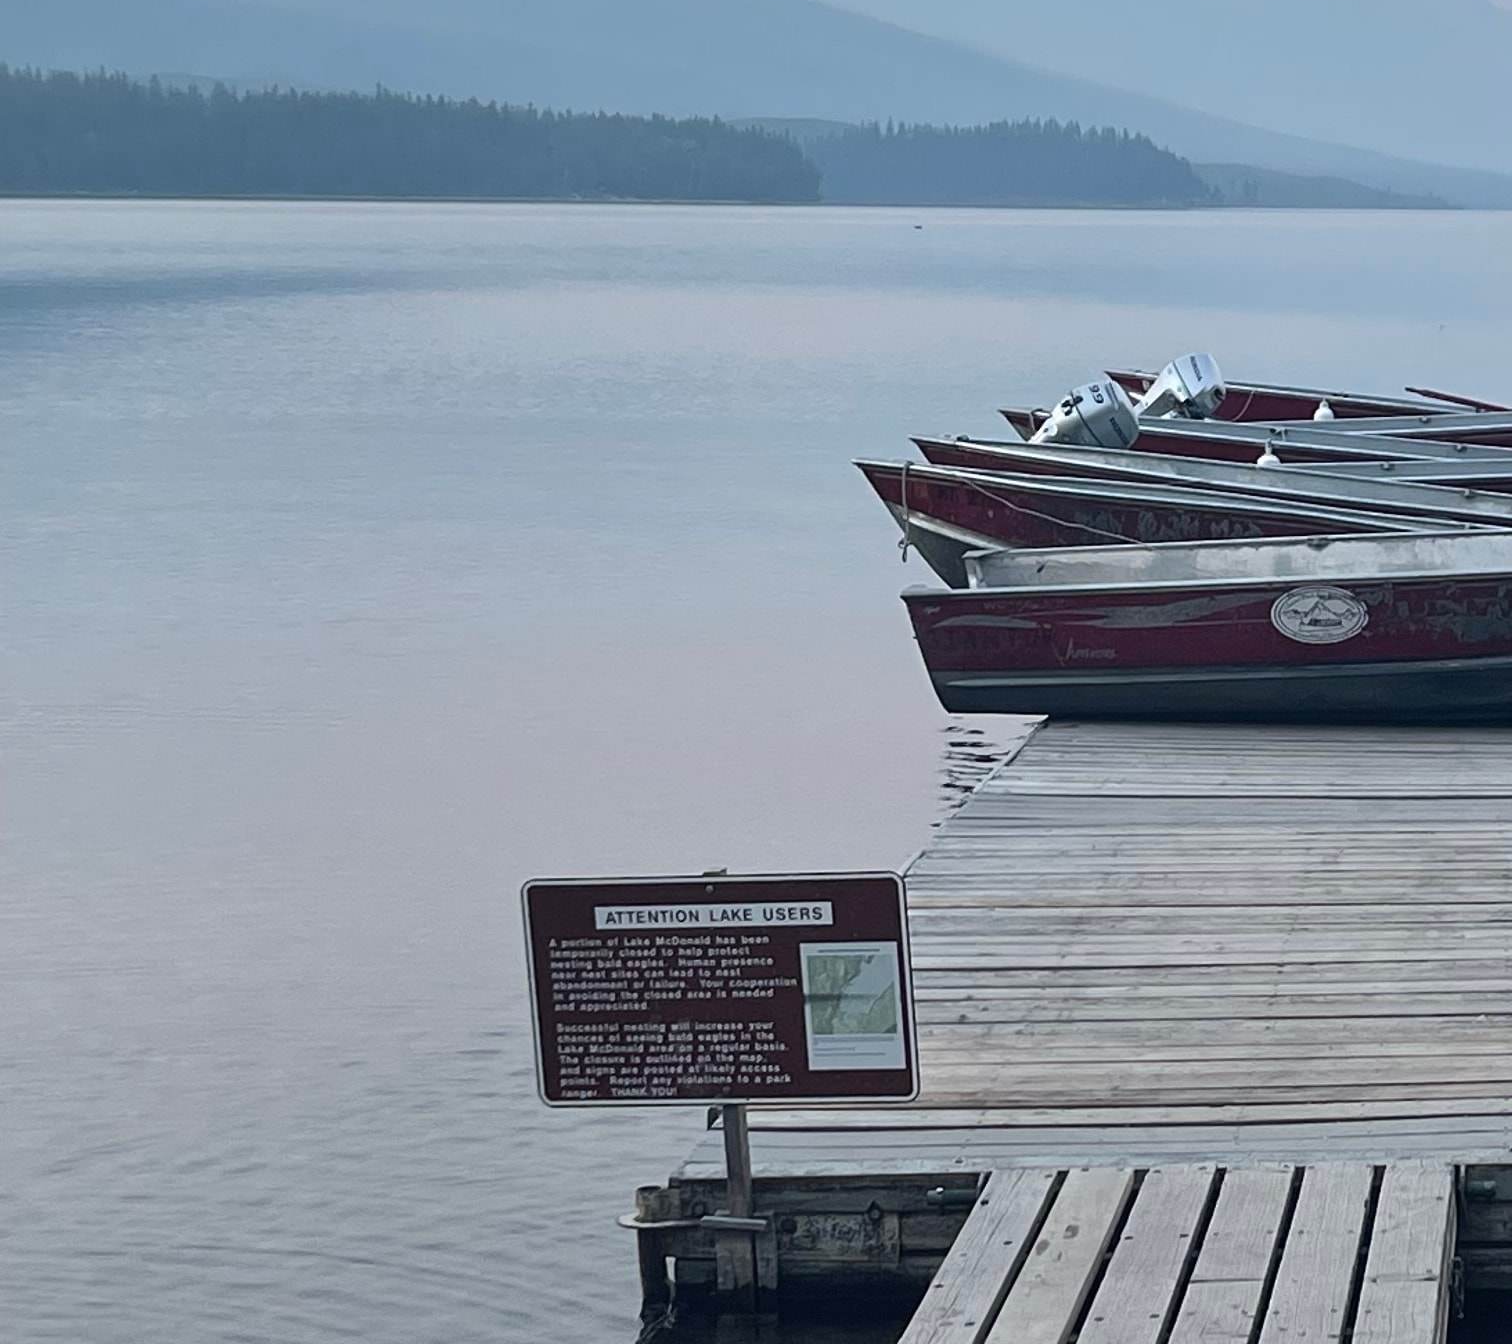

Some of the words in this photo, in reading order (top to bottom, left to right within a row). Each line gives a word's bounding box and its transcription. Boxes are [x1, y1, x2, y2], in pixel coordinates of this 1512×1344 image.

[606, 910, 699, 924] ATTENTION
[710, 908, 753, 922] LAKE
[763, 906, 823, 921] USERS
[549, 938, 557, 947] A
[561, 938, 601, 948] portion
[607, 938, 619, 946] of
[624, 937, 650, 946] Lake
[655, 936, 710, 945] McDonald
[715, 936, 736, 944] has
[741, 936, 770, 944] been
[619, 948, 656, 957] closed
[661, 948, 673, 956] to
[679, 947, 702, 956] help
[708, 946, 750, 956] protect
[550, 959, 592, 969] nesting
[597, 959, 622, 967] bald
[678, 957, 716, 967] Human
[721, 957, 774, 967] presence
[551, 971, 576, 979] near
[582, 970, 606, 978] nest
[611, 970, 639, 978] sites
[644, 970, 665, 978] can
[669, 969, 693, 977] lead
[699, 968, 711, 977] to
[716, 968, 741, 976] nest
[553, 980, 628, 990] abandonment
[699, 979, 724, 988] Your
[729, 977, 798, 988] cooperation
[553, 992, 564, 1000] in
[569, 991, 616, 1001] avoiding
[620, 991, 638, 999] the
[644, 990, 681, 999] closed
[687, 990, 711, 998] area
[716, 990, 727, 998] is
[732, 989, 774, 997] needed
[554, 1003, 575, 1011] and
[556, 1023, 619, 1033] Successful
[623, 1023, 666, 1032] nesting
[695, 1022, 743, 1030] increase
[749, 1022, 774, 1031] your
[557, 1034, 604, 1043] chances
[609, 1034, 620, 1043] of
[626, 1034, 664, 1043] seeing
[668, 1033, 693, 1041] bald
[698, 1033, 736, 1042] eagles
[741, 1032, 751, 1040] in
[756, 1032, 774, 1040] the
[557, 1045, 584, 1054] Lake
[589, 1044, 644, 1053] McDonald
[679, 1044, 693, 1052] on
[698, 1044, 705, 1052] a
[710, 1043, 750, 1052] regular
[559, 1055, 579, 1064] The
[584, 1055, 625, 1064] closure
[631, 1055, 641, 1063] is
[646, 1054, 691, 1063] outlined
[716, 1054, 734, 1062] the
[560, 1066, 580, 1075] and
[585, 1066, 615, 1076] signs
[643, 1065, 683, 1075] posted
[688, 1065, 700, 1073] at
[704, 1064, 736, 1073] likely
[741, 1065, 780, 1073] access
[609, 1076, 647, 1086] Report
[652, 1077, 672, 1086] any
[677, 1075, 733, 1084] violations
[737, 1075, 749, 1083] to
[766, 1074, 791, 1084] park
[611, 1087, 647, 1096] THANK
